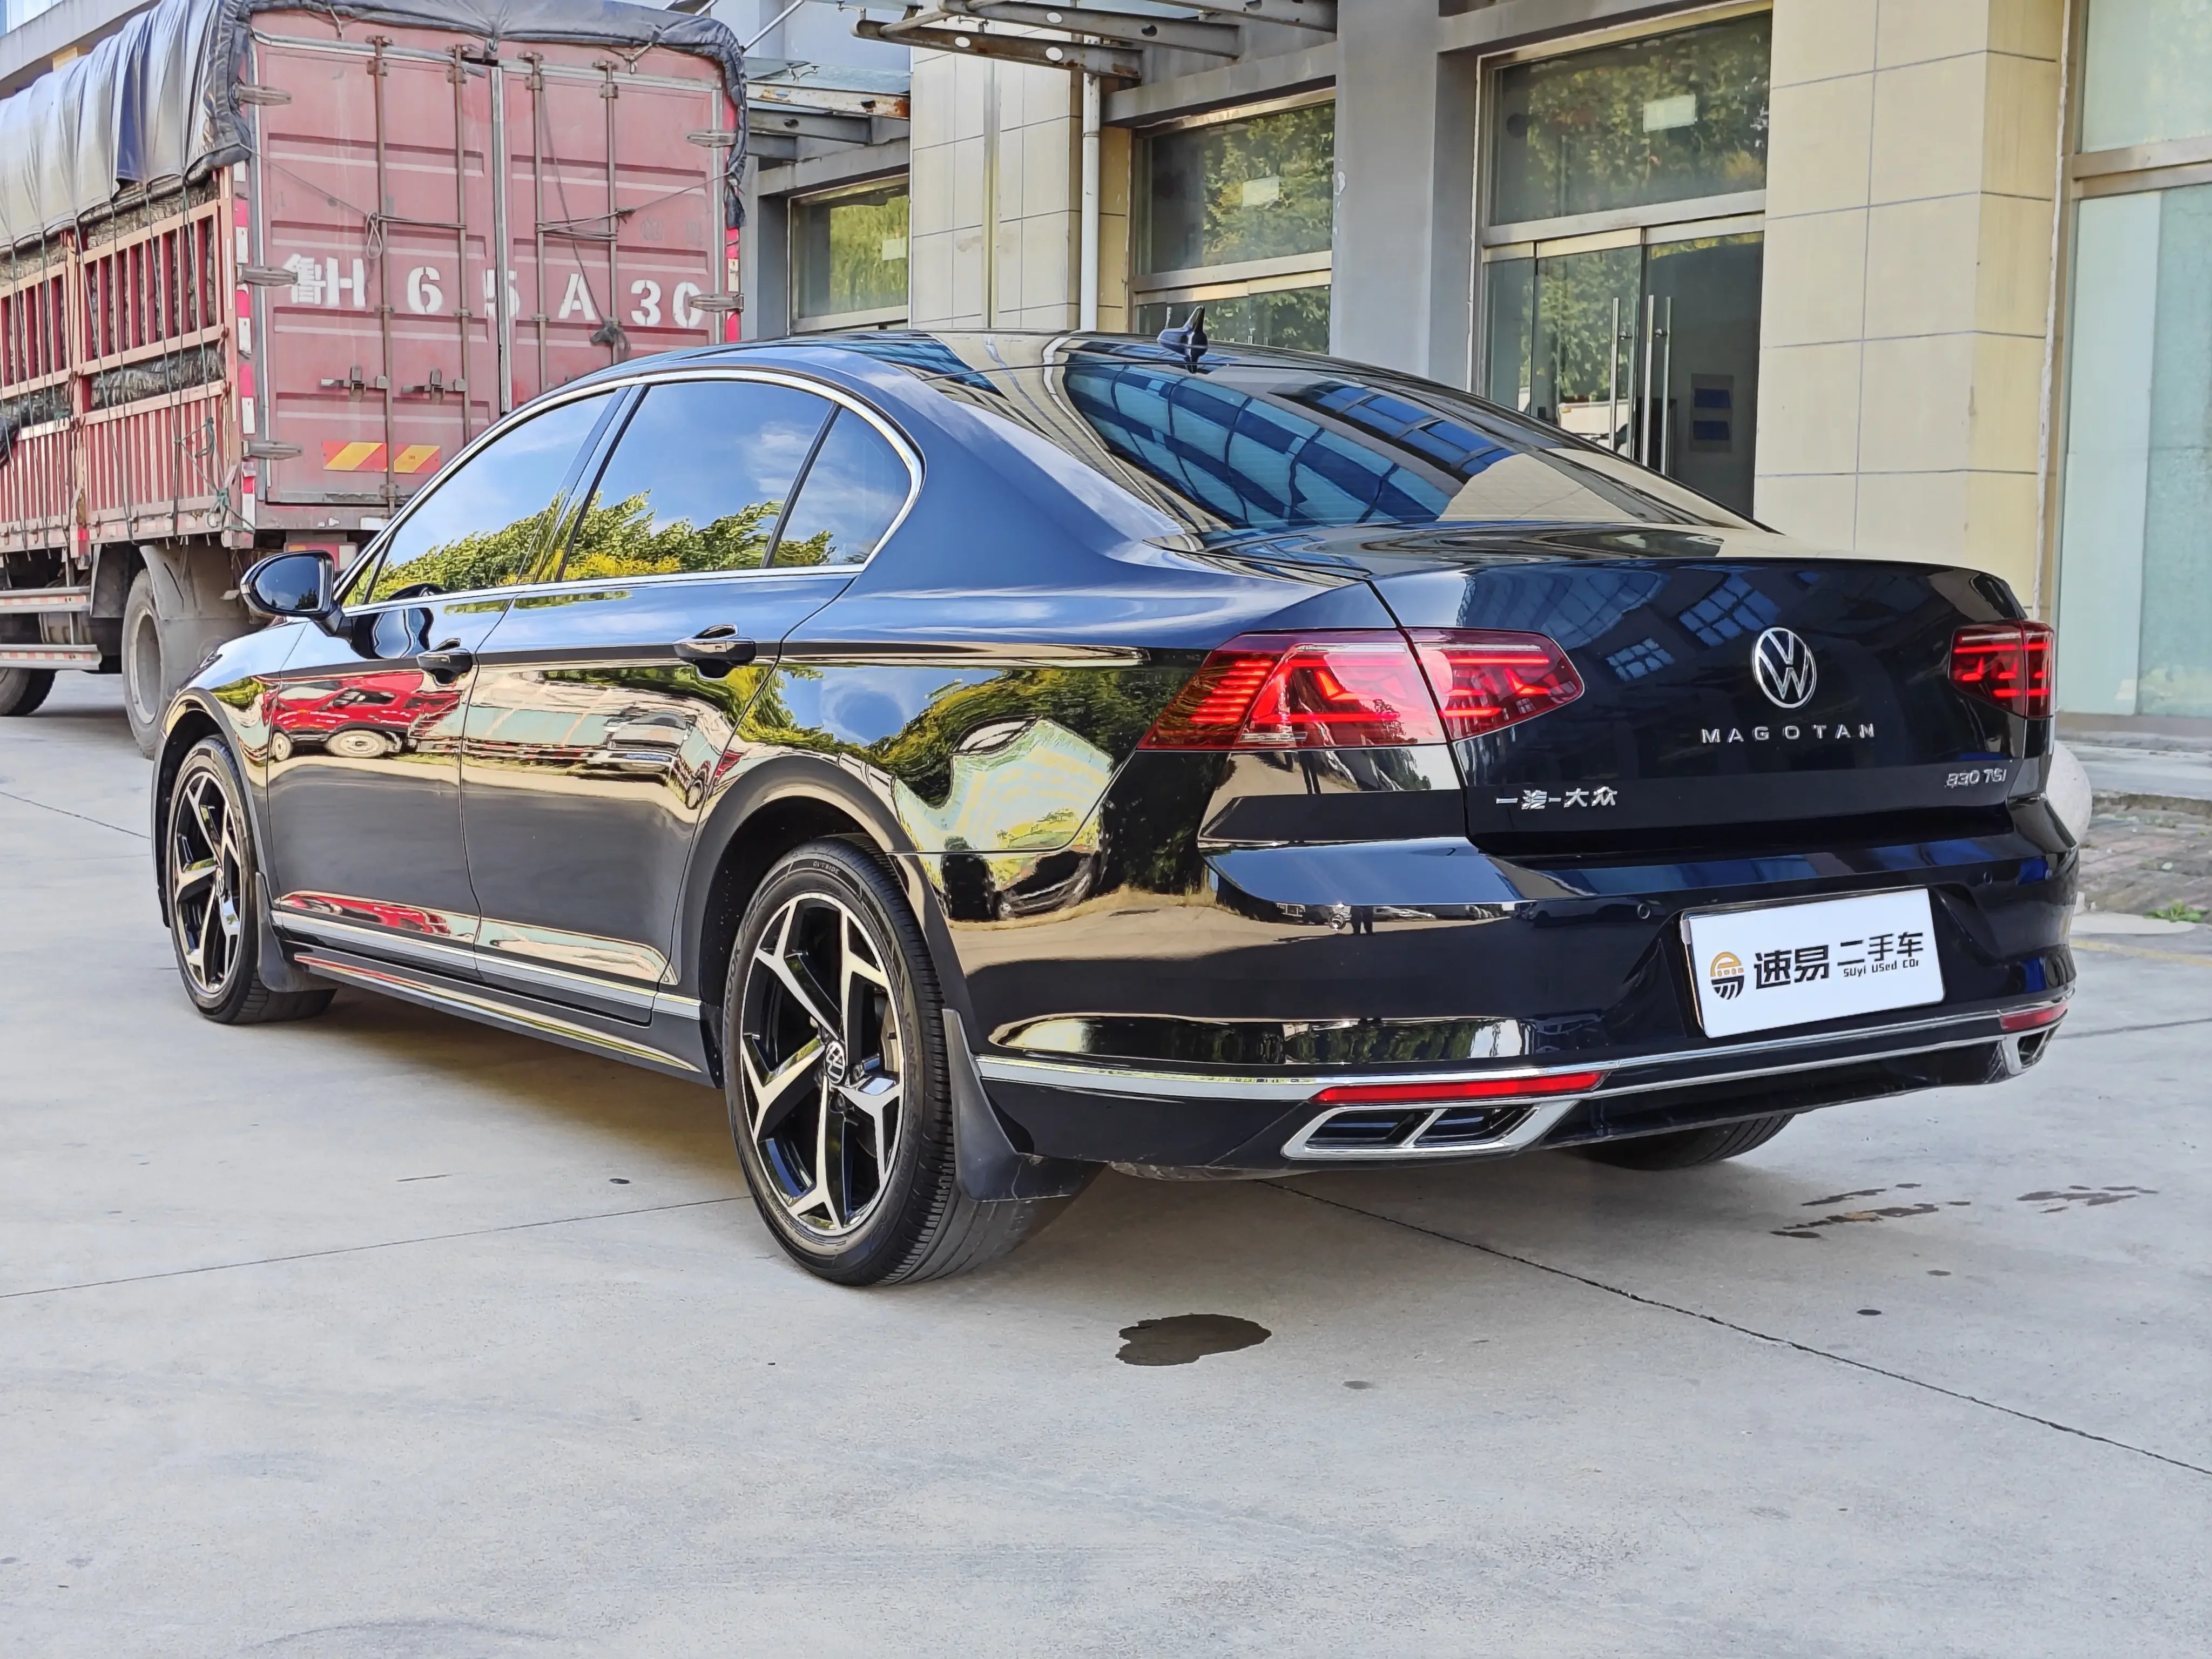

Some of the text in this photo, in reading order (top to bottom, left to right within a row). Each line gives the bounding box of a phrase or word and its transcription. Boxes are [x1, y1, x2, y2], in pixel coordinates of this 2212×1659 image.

[1701, 723, 1874, 744] MAGOTAN
[1984, 767, 2007, 783] TSI
[1754, 932, 1924, 989] 速易 二手车
